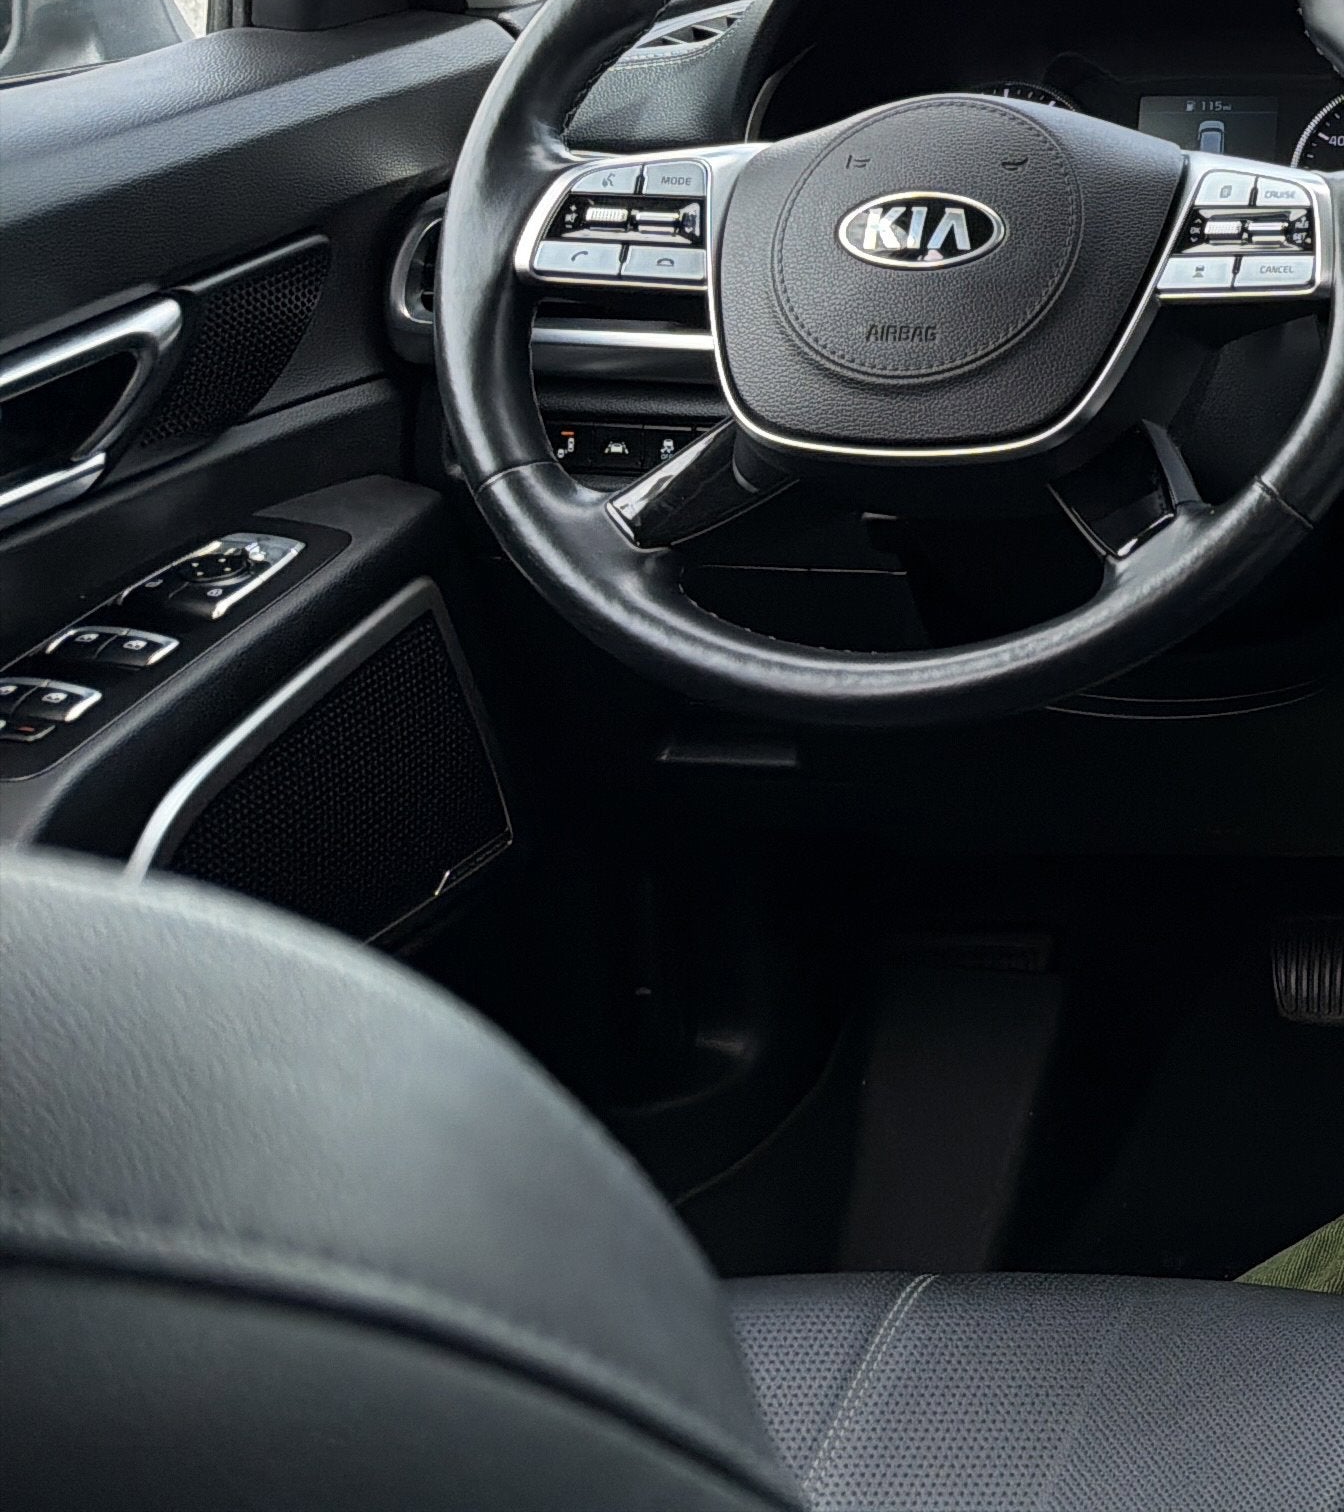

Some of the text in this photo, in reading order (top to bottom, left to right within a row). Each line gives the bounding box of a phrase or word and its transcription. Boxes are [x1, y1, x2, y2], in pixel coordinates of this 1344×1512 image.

[661, 175, 692, 186] MODE
[1264, 190, 1297, 200] CRUISE
[862, 206, 971, 250] KIA
[1259, 265, 1294, 274] CANCEL
[866, 324, 939, 342] AIRBAG
